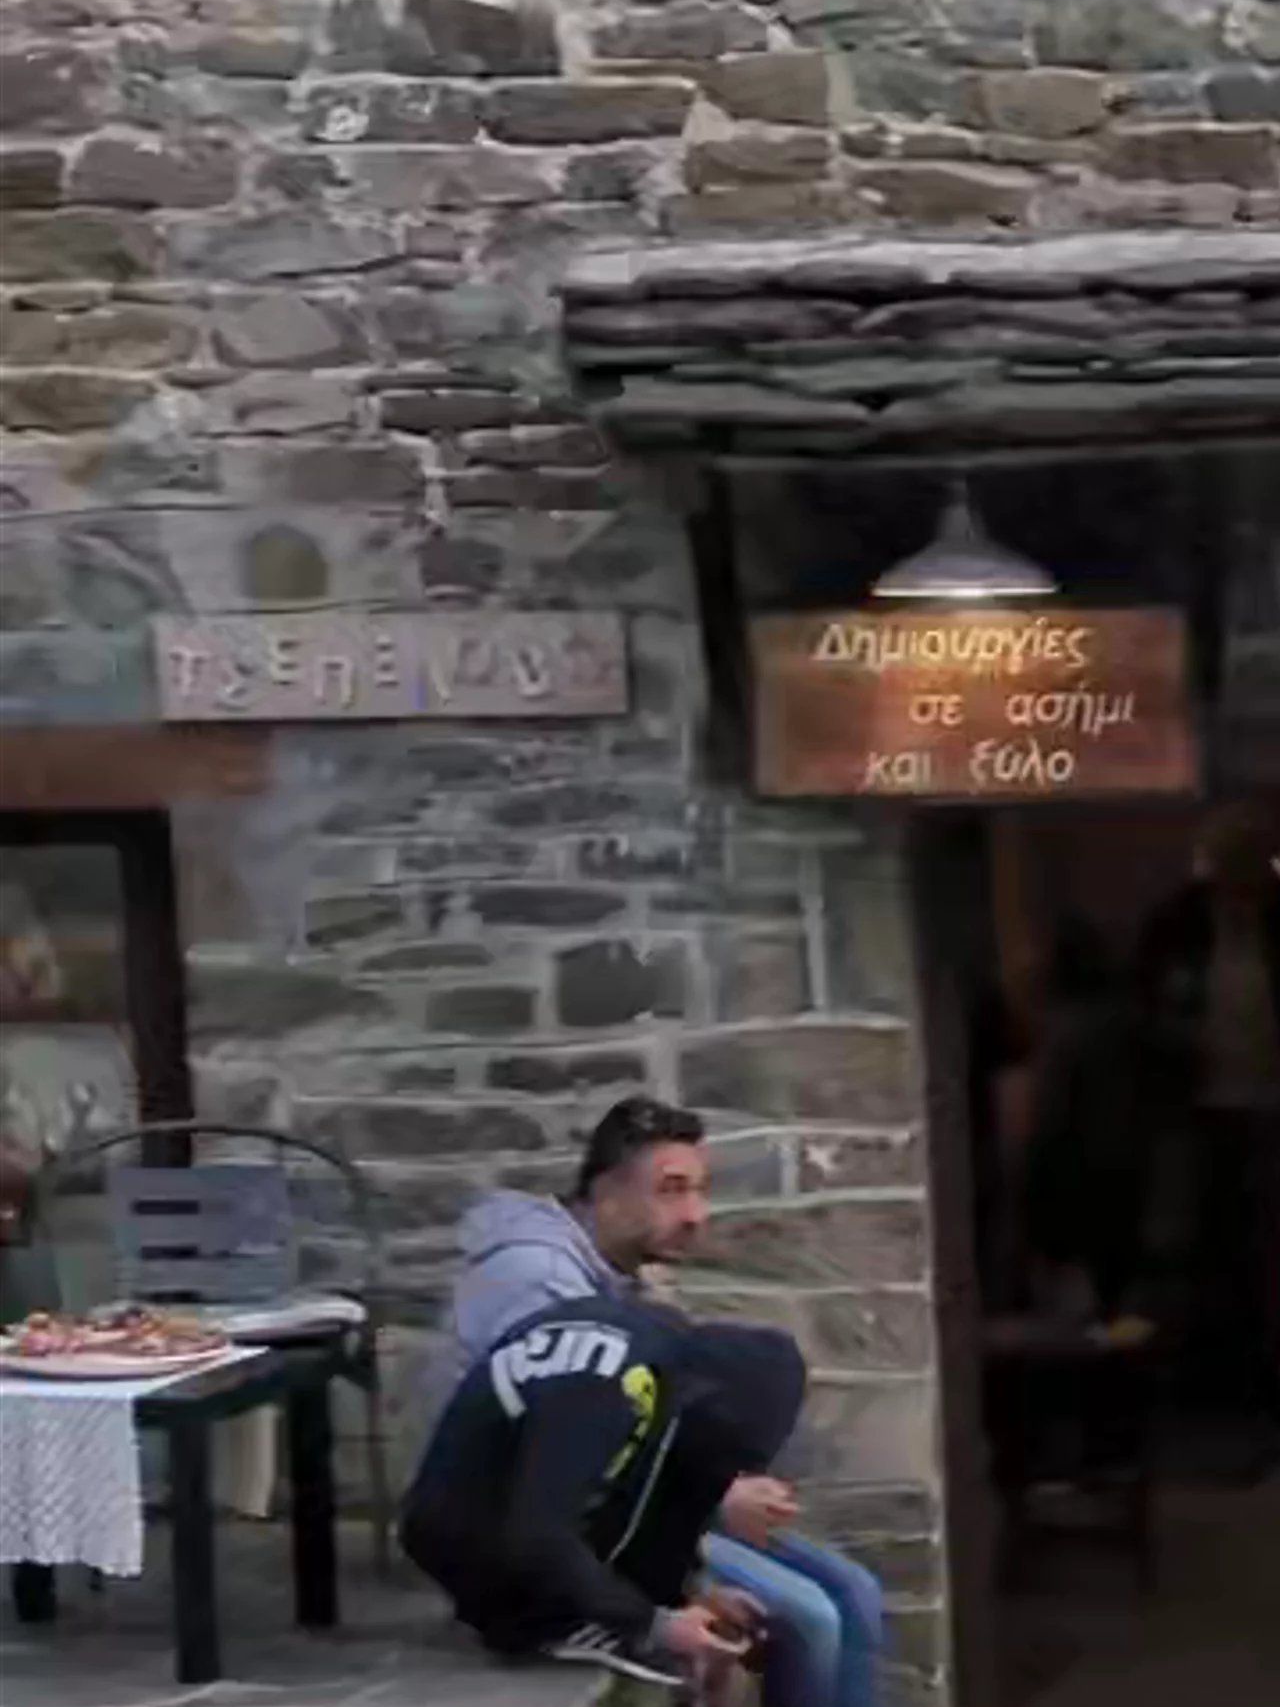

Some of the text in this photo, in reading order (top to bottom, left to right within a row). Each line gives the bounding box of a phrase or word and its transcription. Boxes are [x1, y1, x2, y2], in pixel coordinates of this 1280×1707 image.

[812, 617, 1094, 674] Δημιουργίες
[908, 680, 1137, 736] σε ασήμι
[862, 751, 931, 786] και
